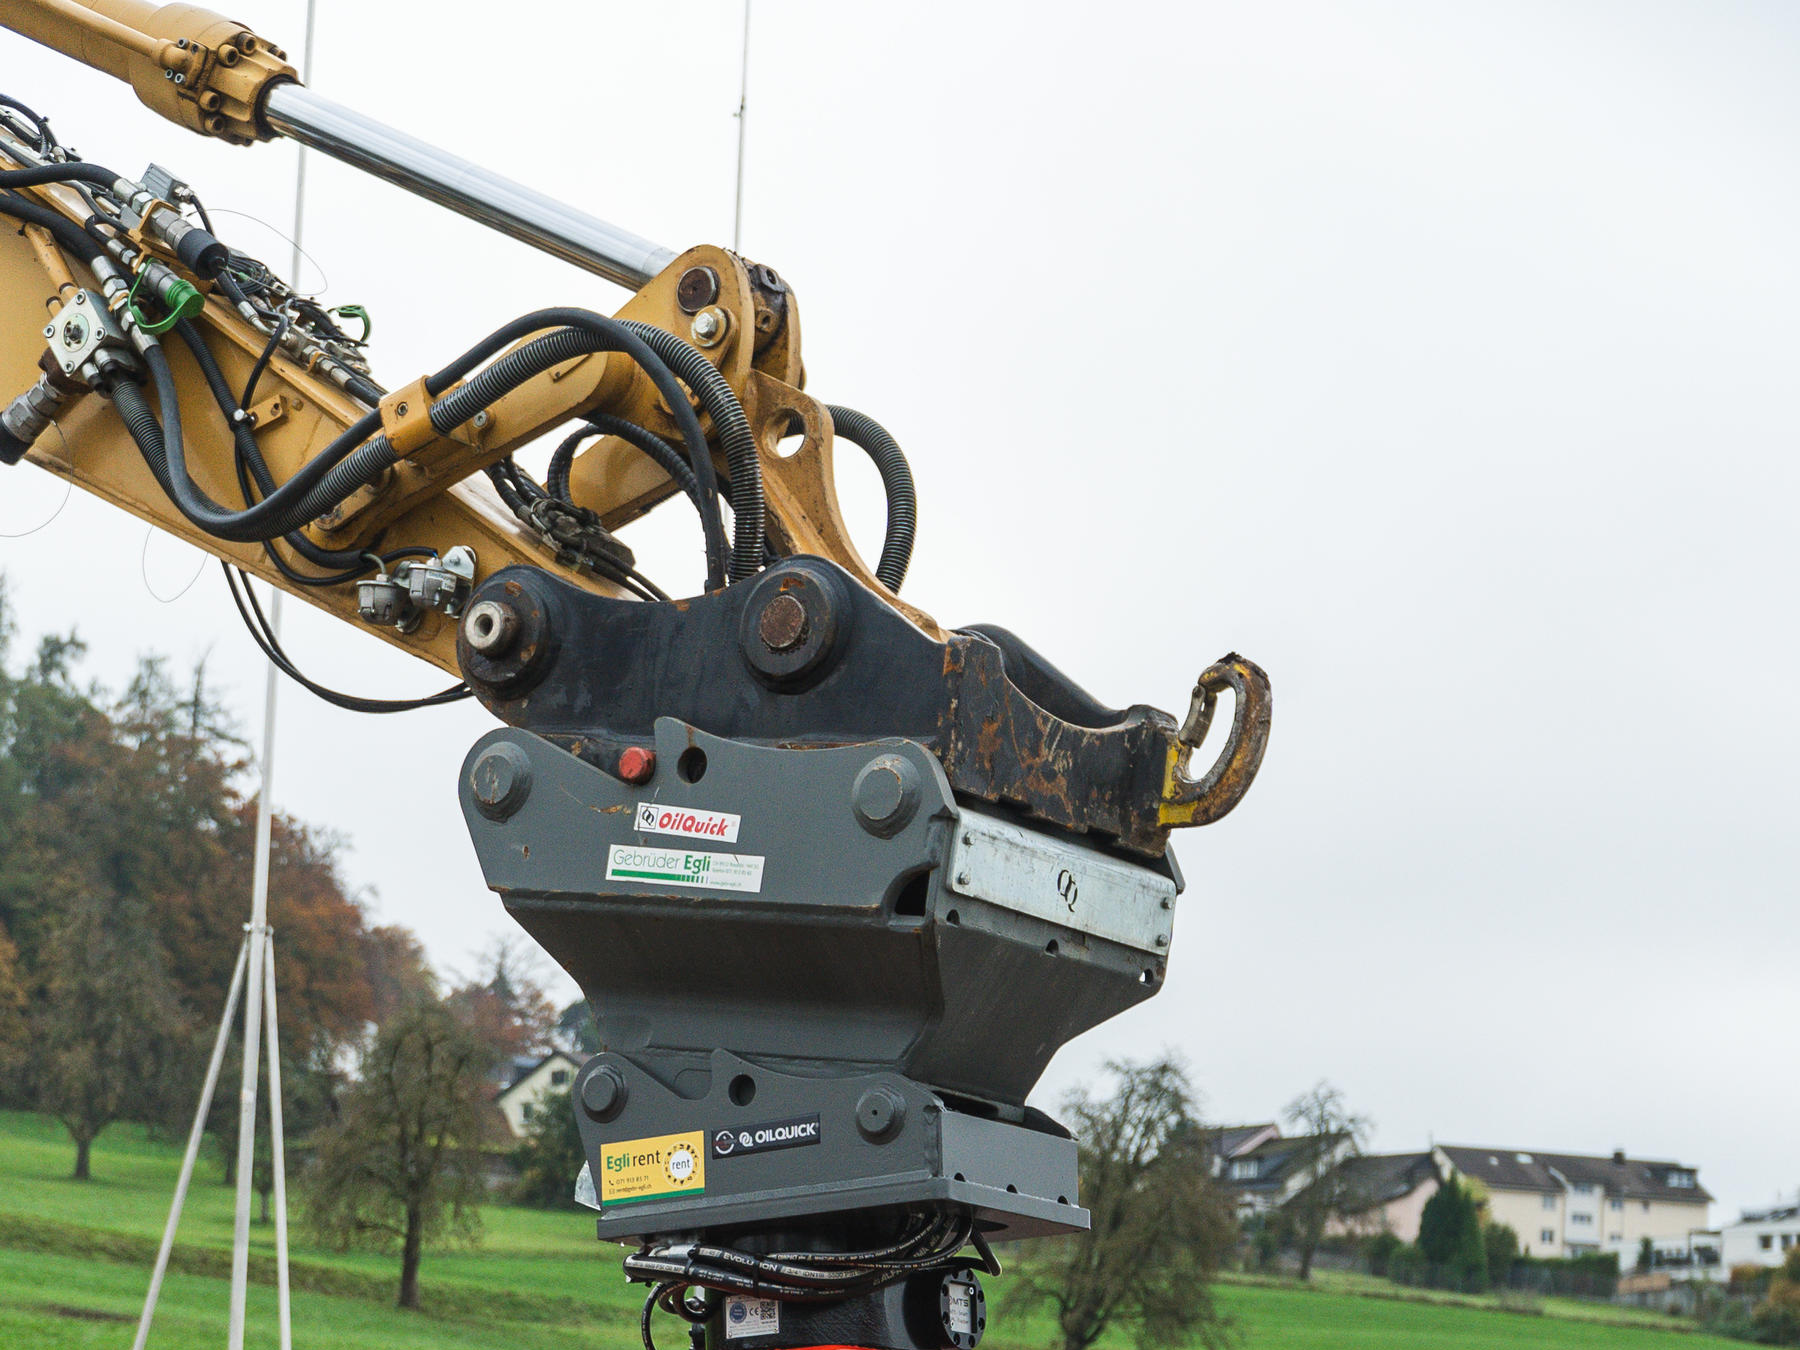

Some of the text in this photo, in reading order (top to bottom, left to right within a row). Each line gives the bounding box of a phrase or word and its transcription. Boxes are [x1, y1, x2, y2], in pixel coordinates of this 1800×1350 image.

[658, 812, 729, 837] OilQuick
[613, 849, 681, 870] Gebrüder
[683, 854, 711, 875] Egli
[754, 1123, 817, 1144] OILQUICK
[606, 1150, 661, 1173] Egli rent
[671, 1158, 691, 1171] rent
[723, 1251, 778, 1272] EVOLUION
